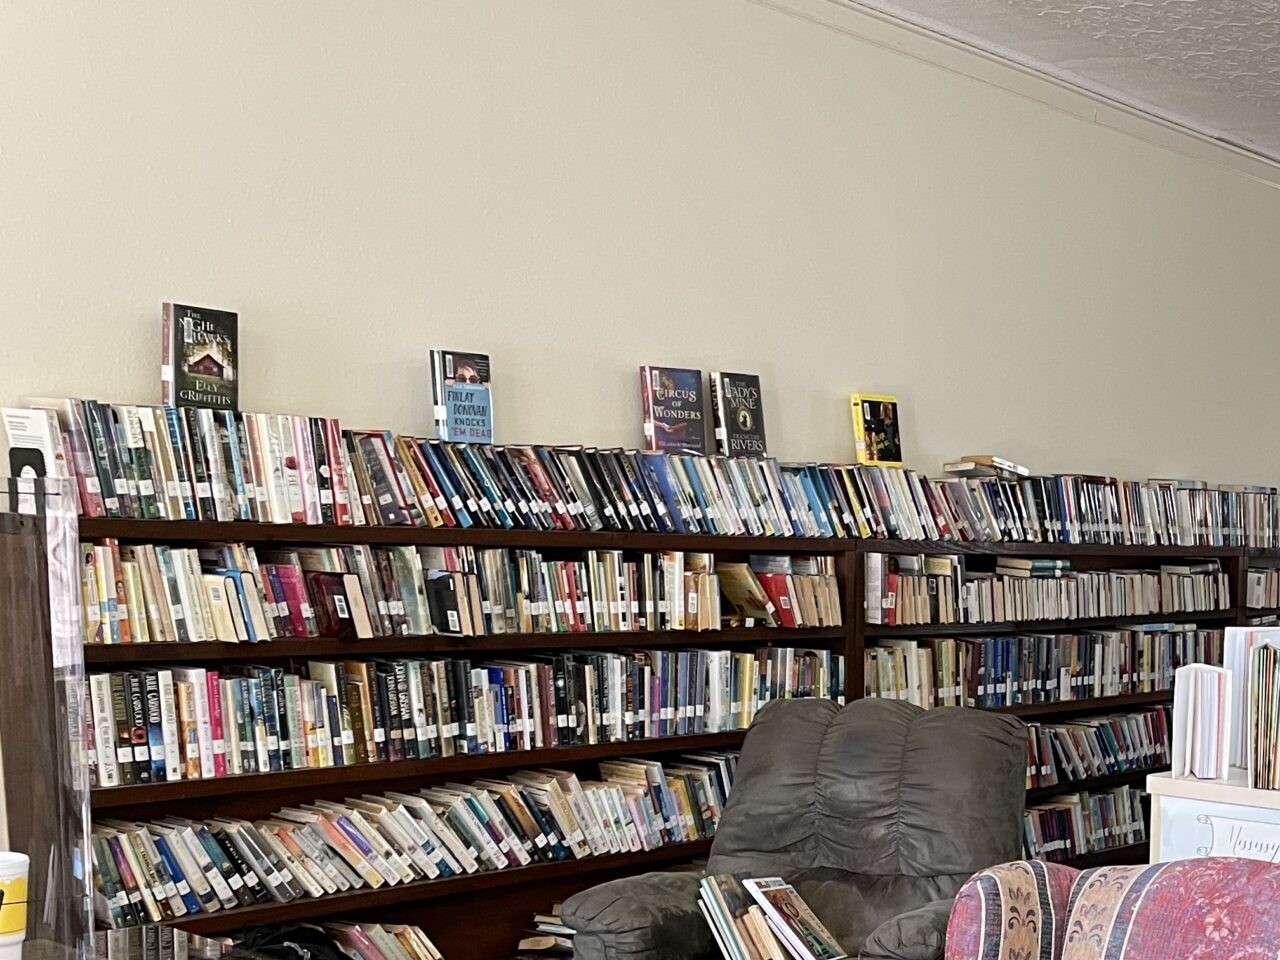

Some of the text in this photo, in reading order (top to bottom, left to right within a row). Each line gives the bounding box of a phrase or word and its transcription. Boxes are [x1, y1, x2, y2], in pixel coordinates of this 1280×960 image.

[179, 317, 214, 331] NGHT
[196, 380, 220, 393] ELLY
[180, 390, 231, 405] GRIFFITHS
[447, 390, 475, 403] FINLAY
[656, 388, 697, 402] CIRCUS
[453, 403, 488, 417] DONOVAN
[671, 400, 683, 408] OF
[653, 405, 701, 420] WONDERS
[454, 417, 487, 427] KNOCKS
[469, 428, 493, 439] DEAD
[731, 439, 764, 451] RIVERS
[144, 673, 161, 723] JULIE GARWOOD
[394, 664, 412, 720] JOHN GRISHAM
[128, 674, 144, 727] JULIE GARWOOD
[387, 689, 399, 716] GRISHAM
